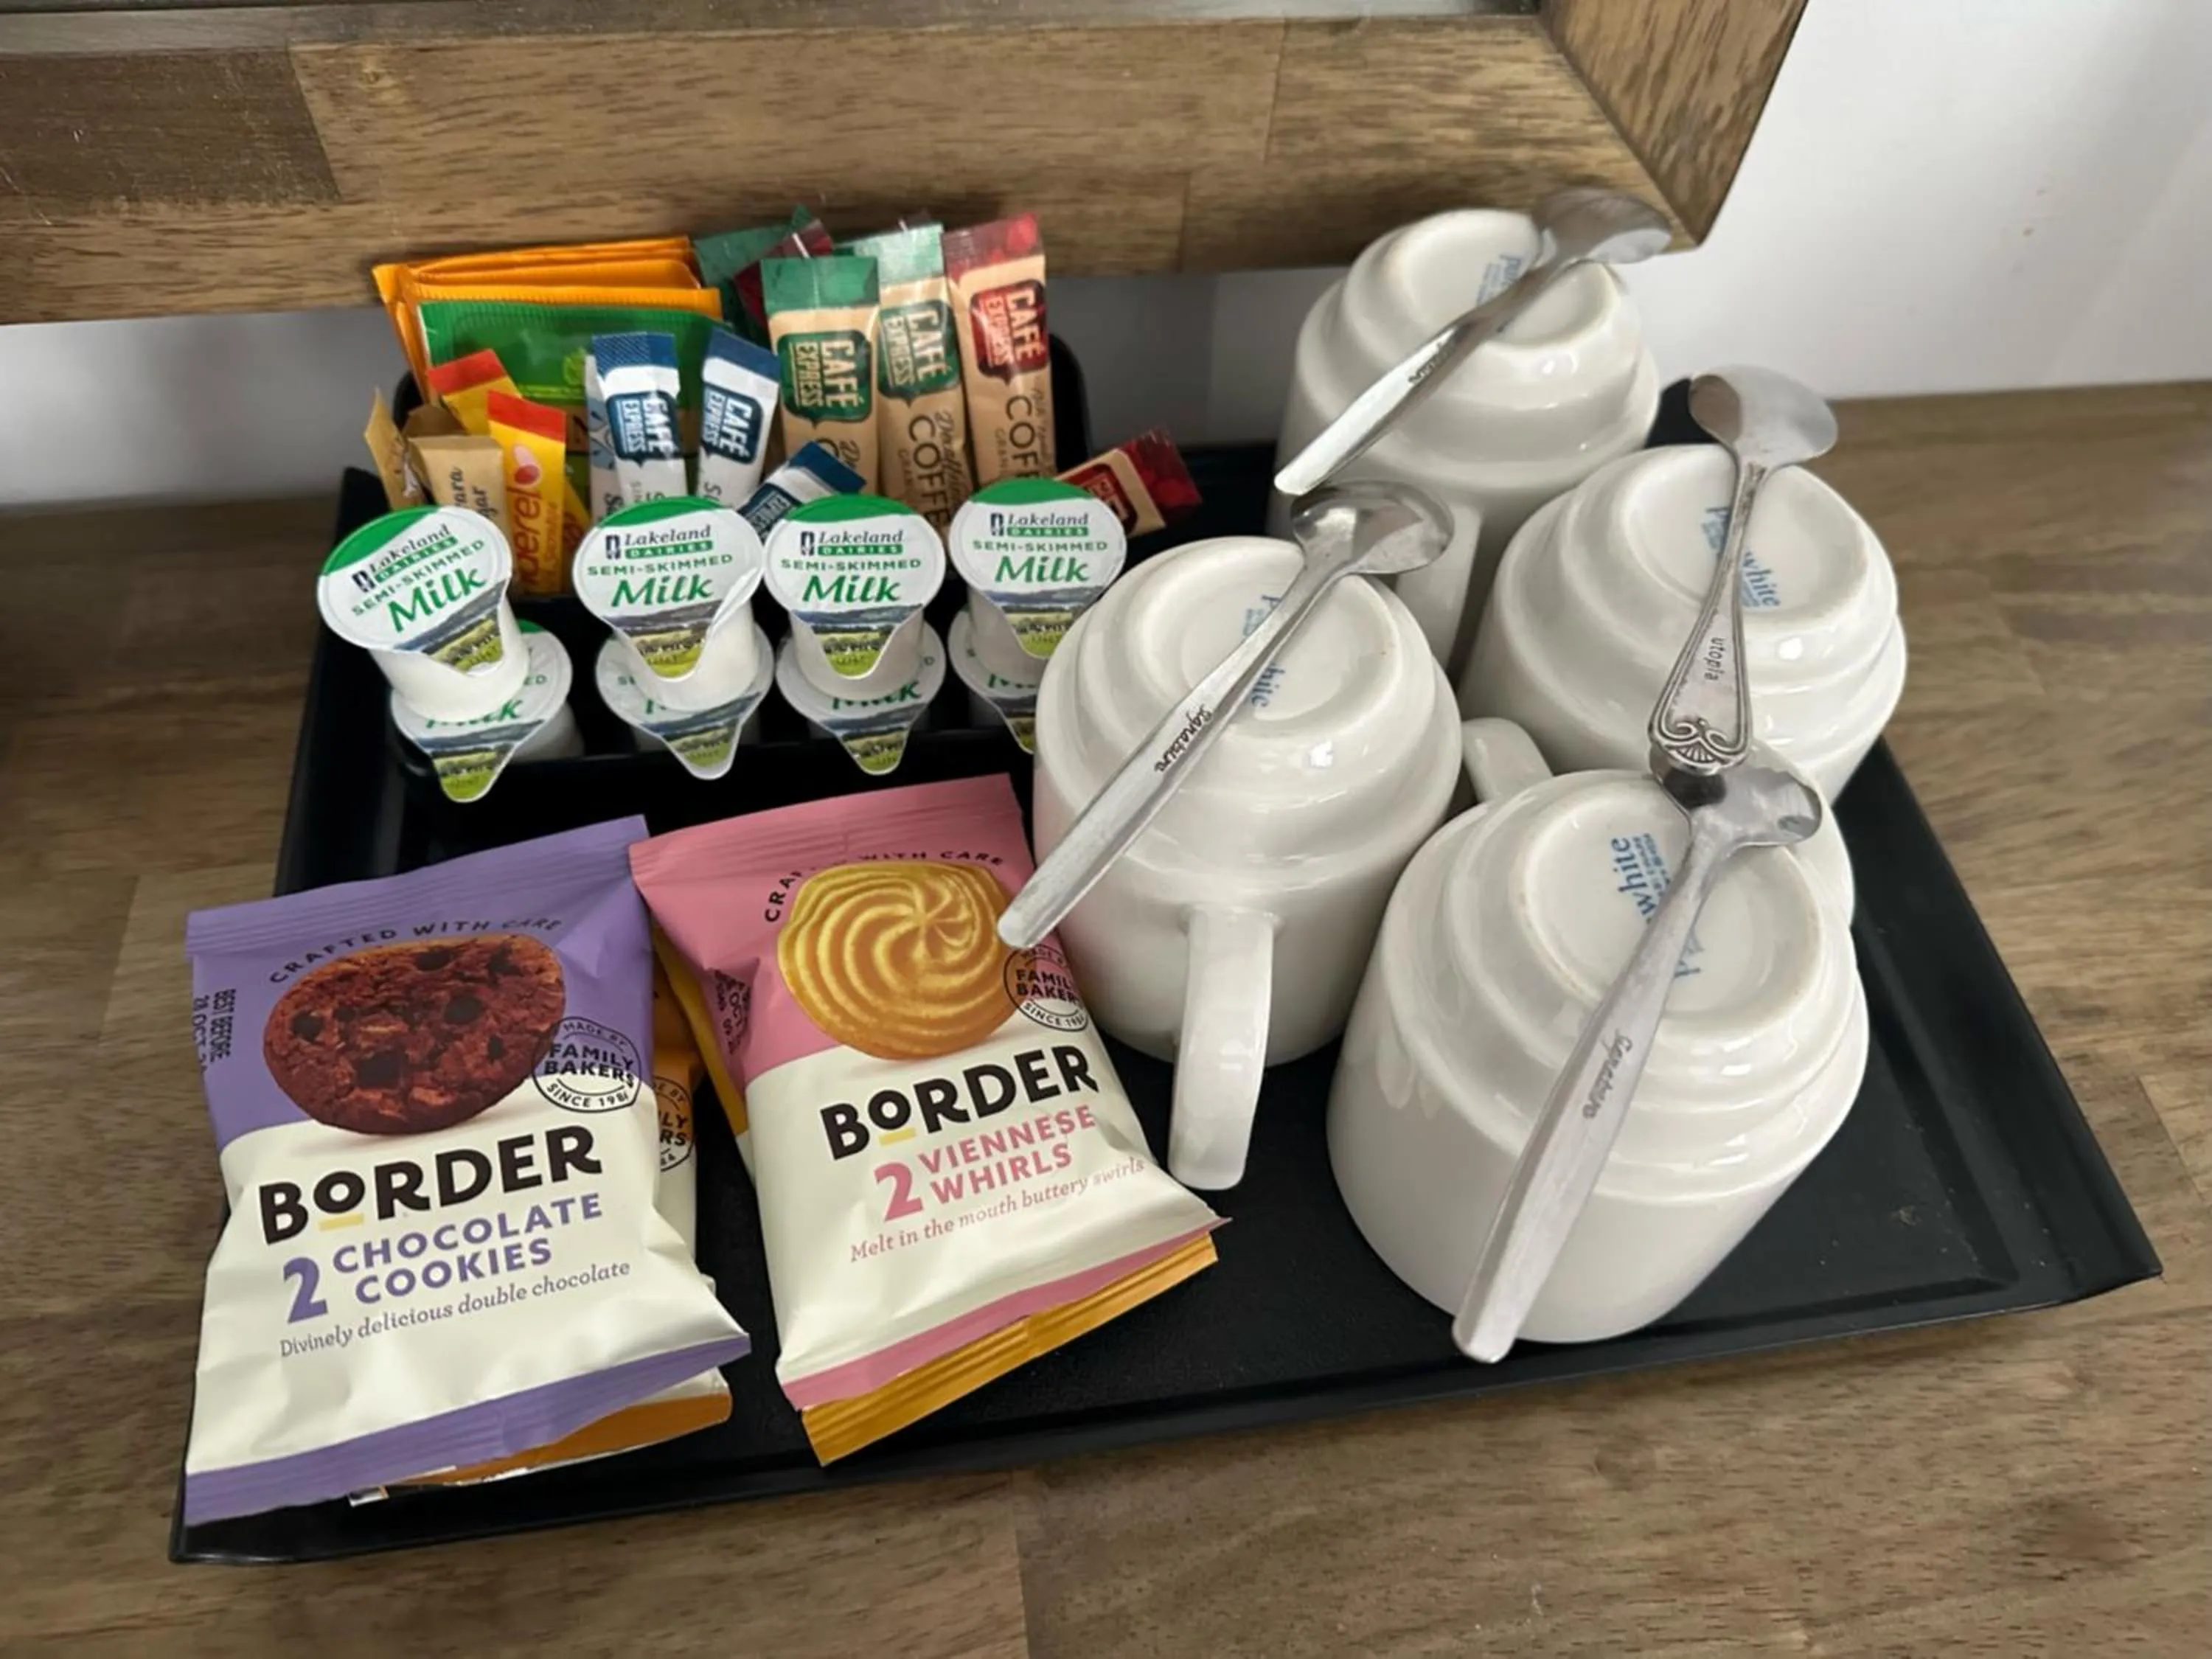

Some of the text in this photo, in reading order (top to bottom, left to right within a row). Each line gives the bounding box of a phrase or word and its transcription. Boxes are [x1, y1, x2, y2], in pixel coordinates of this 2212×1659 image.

[886, 316, 914, 386] EXPRESS
[907, 310, 952, 382] CAFÉ
[1006, 290, 1046, 360] CAFÉ
[796, 341, 823, 406] EXPRESS
[821, 340, 865, 407] CAFÉ
[720, 398, 754, 458] CAFÉ
[908, 414, 951, 525] COFFE
[369, 523, 451, 574] Lakeland
[625, 524, 711, 546] Lakeland
[628, 541, 711, 558] DAIRIES
[819, 529, 903, 543] Lakeland
[821, 544, 901, 555] DAIRIES
[973, 540, 1107, 552] SEMI-SKIMMED
[1008, 513, 1089, 526] Lakeland
[1010, 527, 1086, 537] DAIRIES
[352, 540, 484, 616] SEMI-SKIMMED
[588, 554, 733, 576] SEMI-SKIMMED
[611, 574, 713, 607] Milk
[781, 559, 921, 571] SEMI-SKIMMED
[802, 574, 901, 602] Milk
[995, 555, 1090, 582] Milk
[388, 568, 486, 633] Milk
[1252, 664, 1286, 708] hite
[1704, 636, 1726, 682] utopia
[1154, 704, 1213, 773] Signature
[941, 850, 1004, 866] CARE
[1611, 836, 1658, 917] white
[269, 918, 563, 984] CRAFTED WITH CARE
[1023, 1003, 1061, 1026] SINCE
[544, 1060, 635, 1089] BAKERS
[549, 1043, 633, 1071] FAMILY
[546, 1083, 591, 1107] SINCE
[820, 1045, 1099, 1161] BORDER
[917, 1104, 1096, 1175] VIENNESE
[259, 1125, 602, 1245] BORDER
[874, 1161, 924, 1222] 2
[930, 1143, 1072, 1206] WHIRLS
[333, 1192, 602, 1274] CHOCOLATE
[850, 1158, 1145, 1263] Melt in the mouth buttery swirls
[282, 1256, 329, 1324] 2
[355, 1237, 552, 1305] COOKIES
[279, 1262, 631, 1357] Divinely delicious double chocolate
